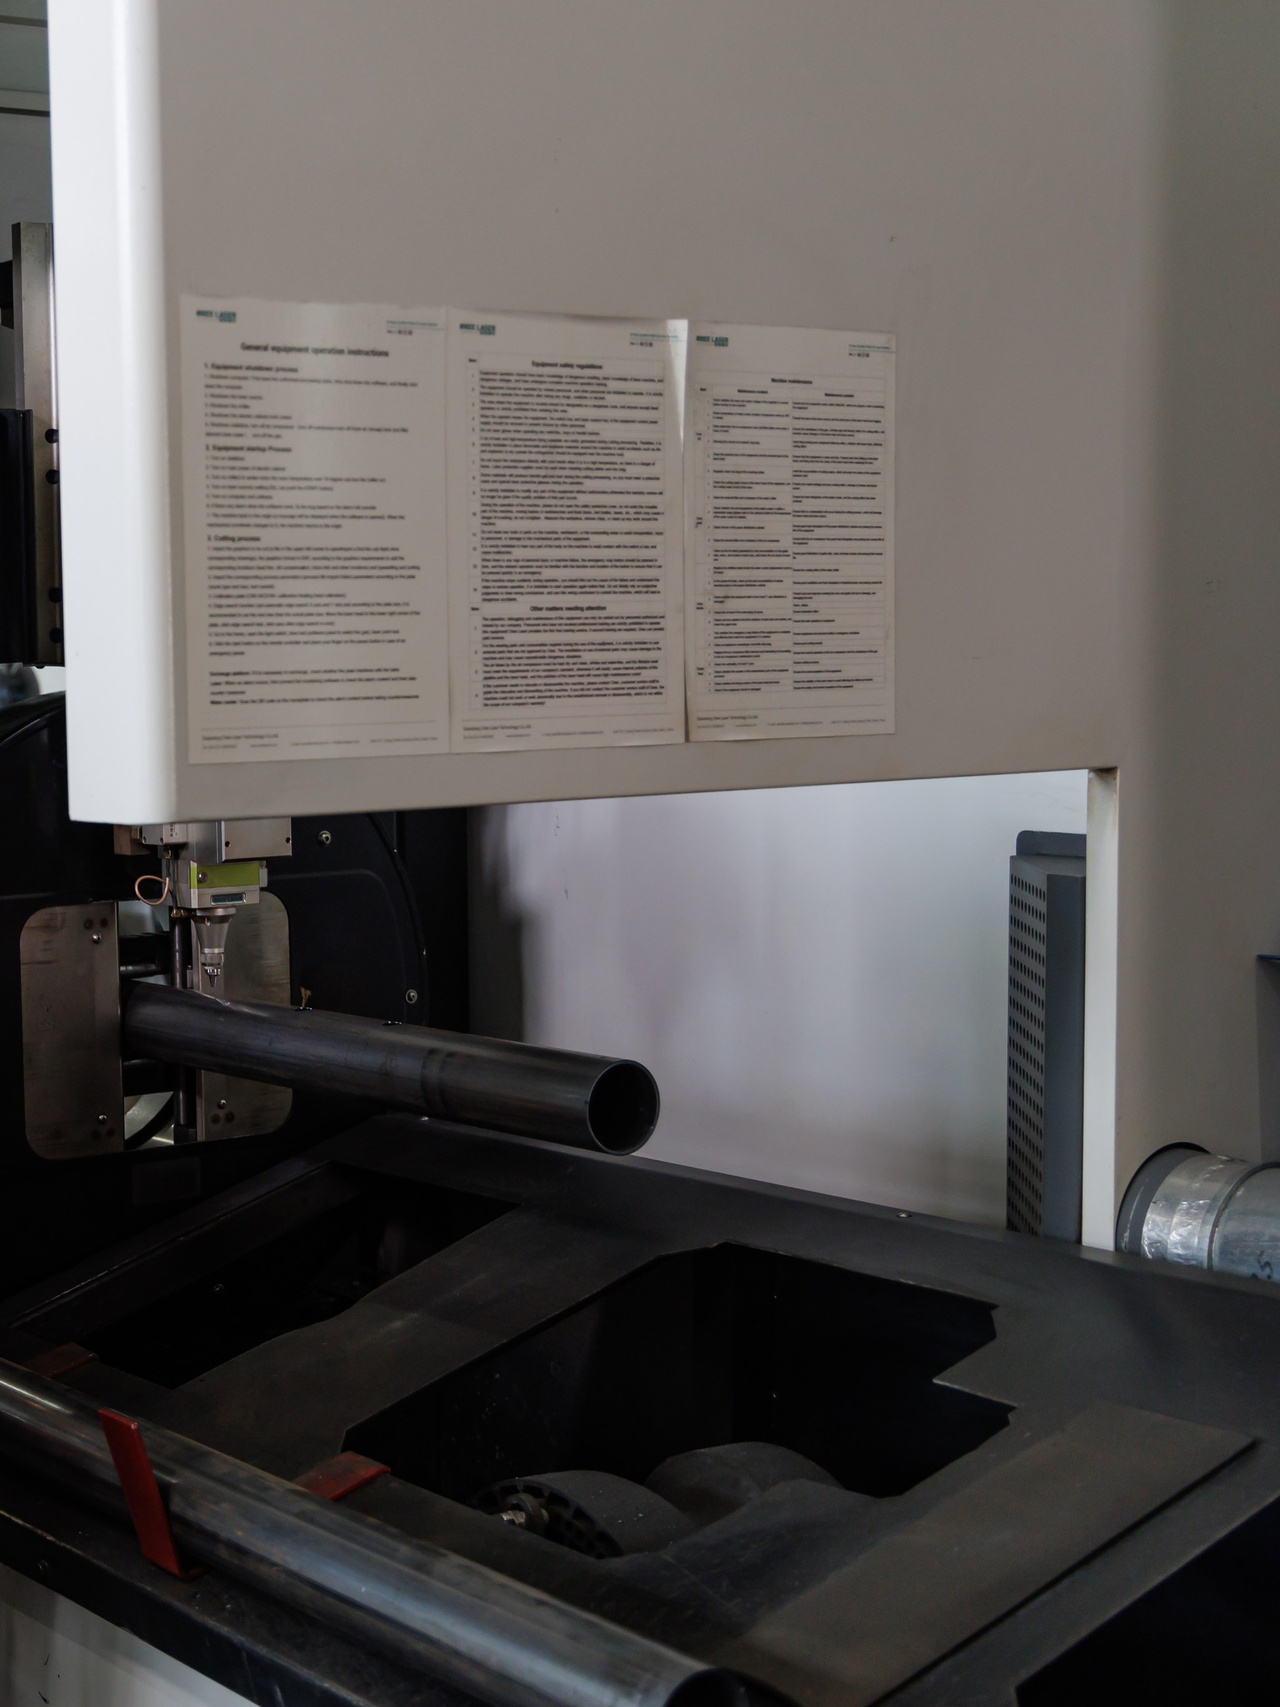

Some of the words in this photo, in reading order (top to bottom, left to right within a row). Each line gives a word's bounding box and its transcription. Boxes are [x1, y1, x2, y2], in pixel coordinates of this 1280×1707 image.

[240, 342, 268, 352] General
[271, 345, 310, 356] equipment
[311, 346, 345, 356] operation
[347, 346, 389, 357] instructions
[531, 360, 558, 368] Equipment
